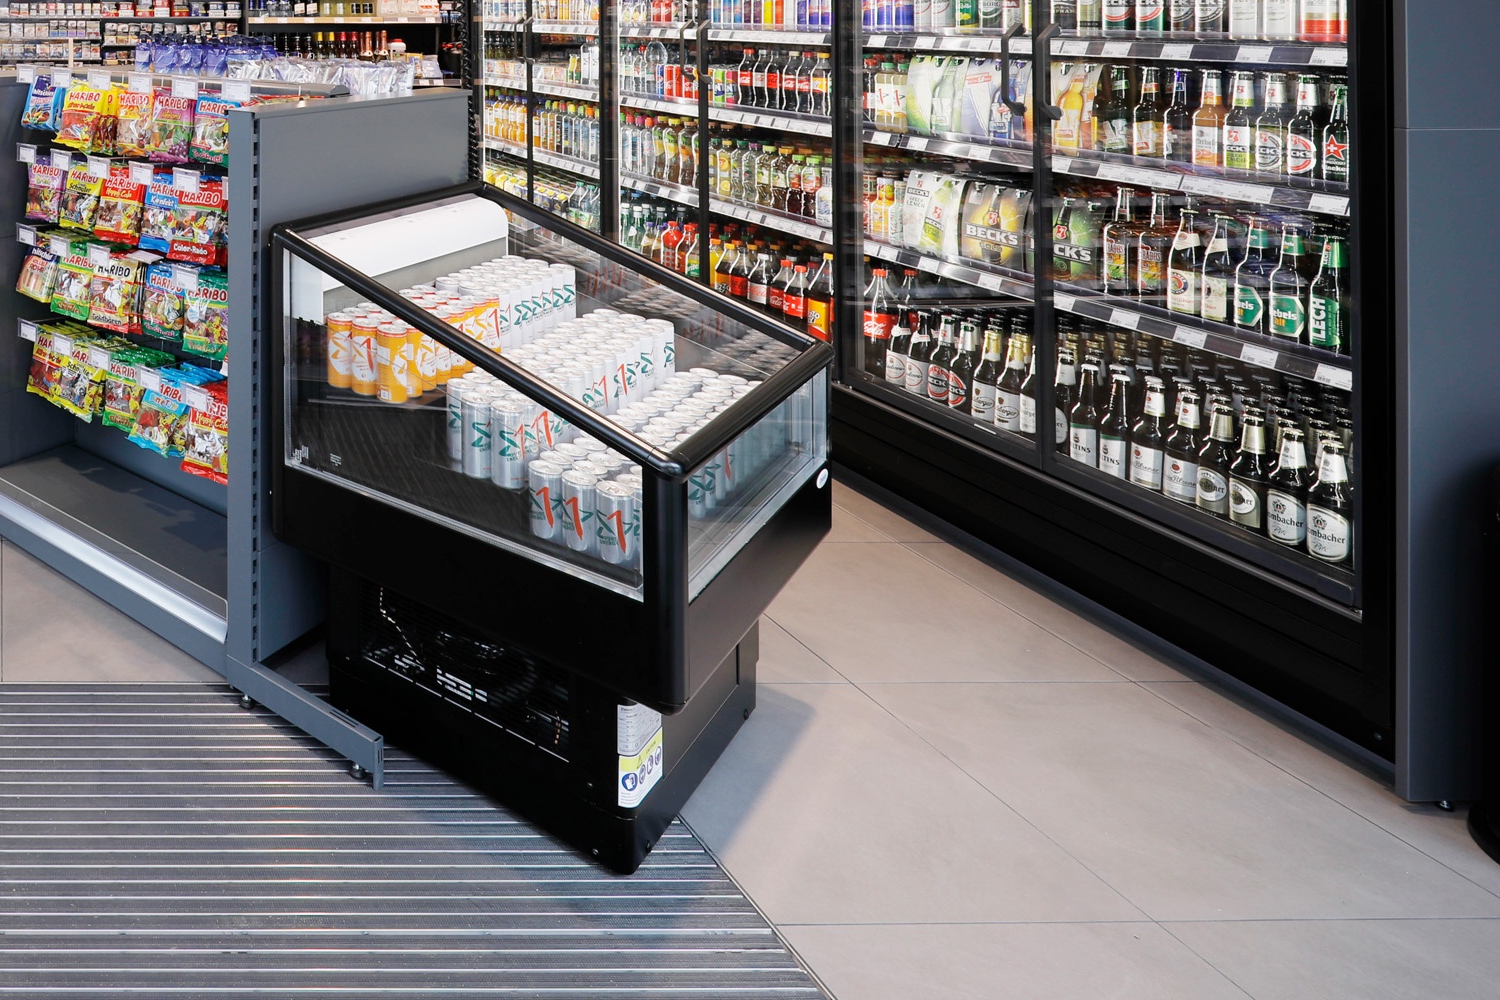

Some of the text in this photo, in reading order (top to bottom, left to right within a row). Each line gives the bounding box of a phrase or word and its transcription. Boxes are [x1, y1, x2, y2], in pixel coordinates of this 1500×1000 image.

[69, 92, 100, 102] HARIBO
[120, 94, 150, 106] HARIBO
[158, 98, 188, 110] HARIBO
[183, 191, 220, 205] HARIBO
[966, 225, 1019, 246] BECK'S
[173, 243, 208, 255] Color-Rado
[1312, 298, 1326, 341] LECH
